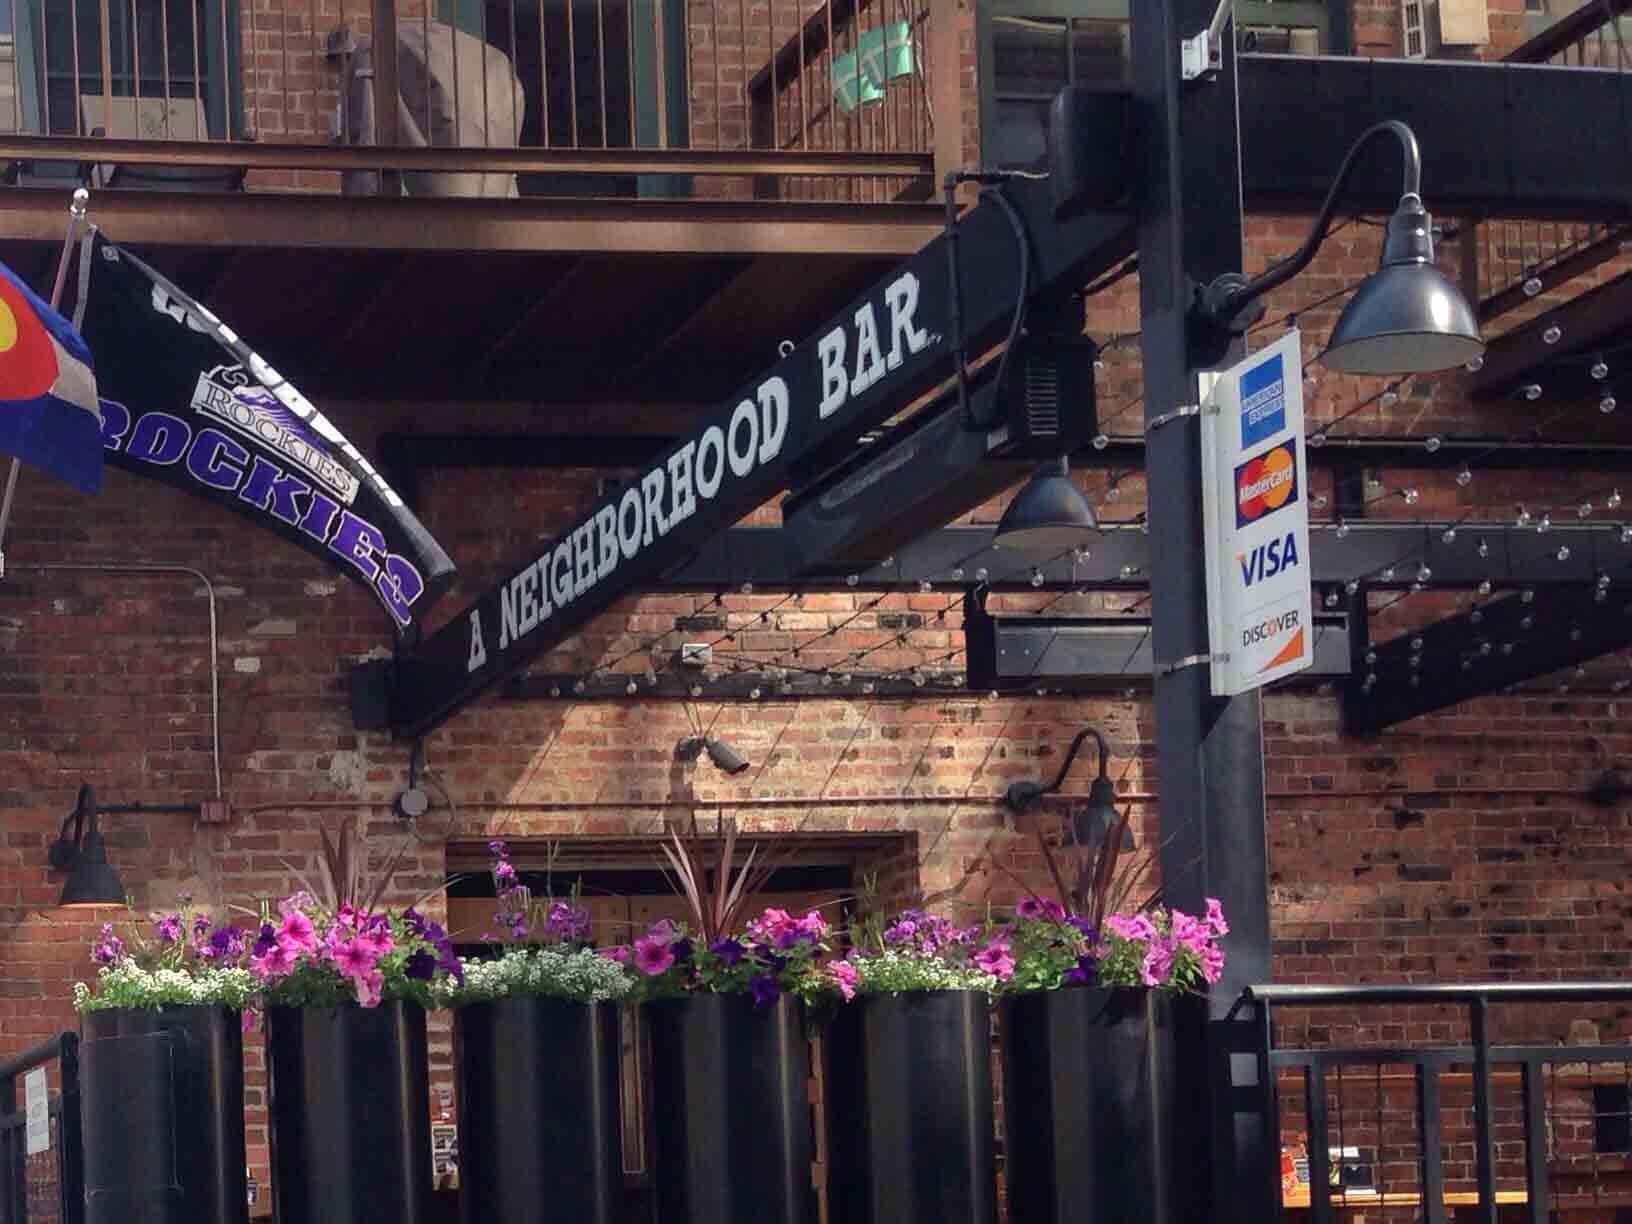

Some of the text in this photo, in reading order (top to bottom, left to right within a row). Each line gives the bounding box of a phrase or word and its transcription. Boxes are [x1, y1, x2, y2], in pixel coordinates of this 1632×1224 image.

[202, 383, 352, 491] ROCKIES
[468, 609, 487, 672] A
[500, 376, 790, 649] NEIGHBORHOOD
[819, 271, 928, 419] BAR
[1237, 533, 1298, 587] VISA
[1243, 610, 1298, 647] DISCOVER
